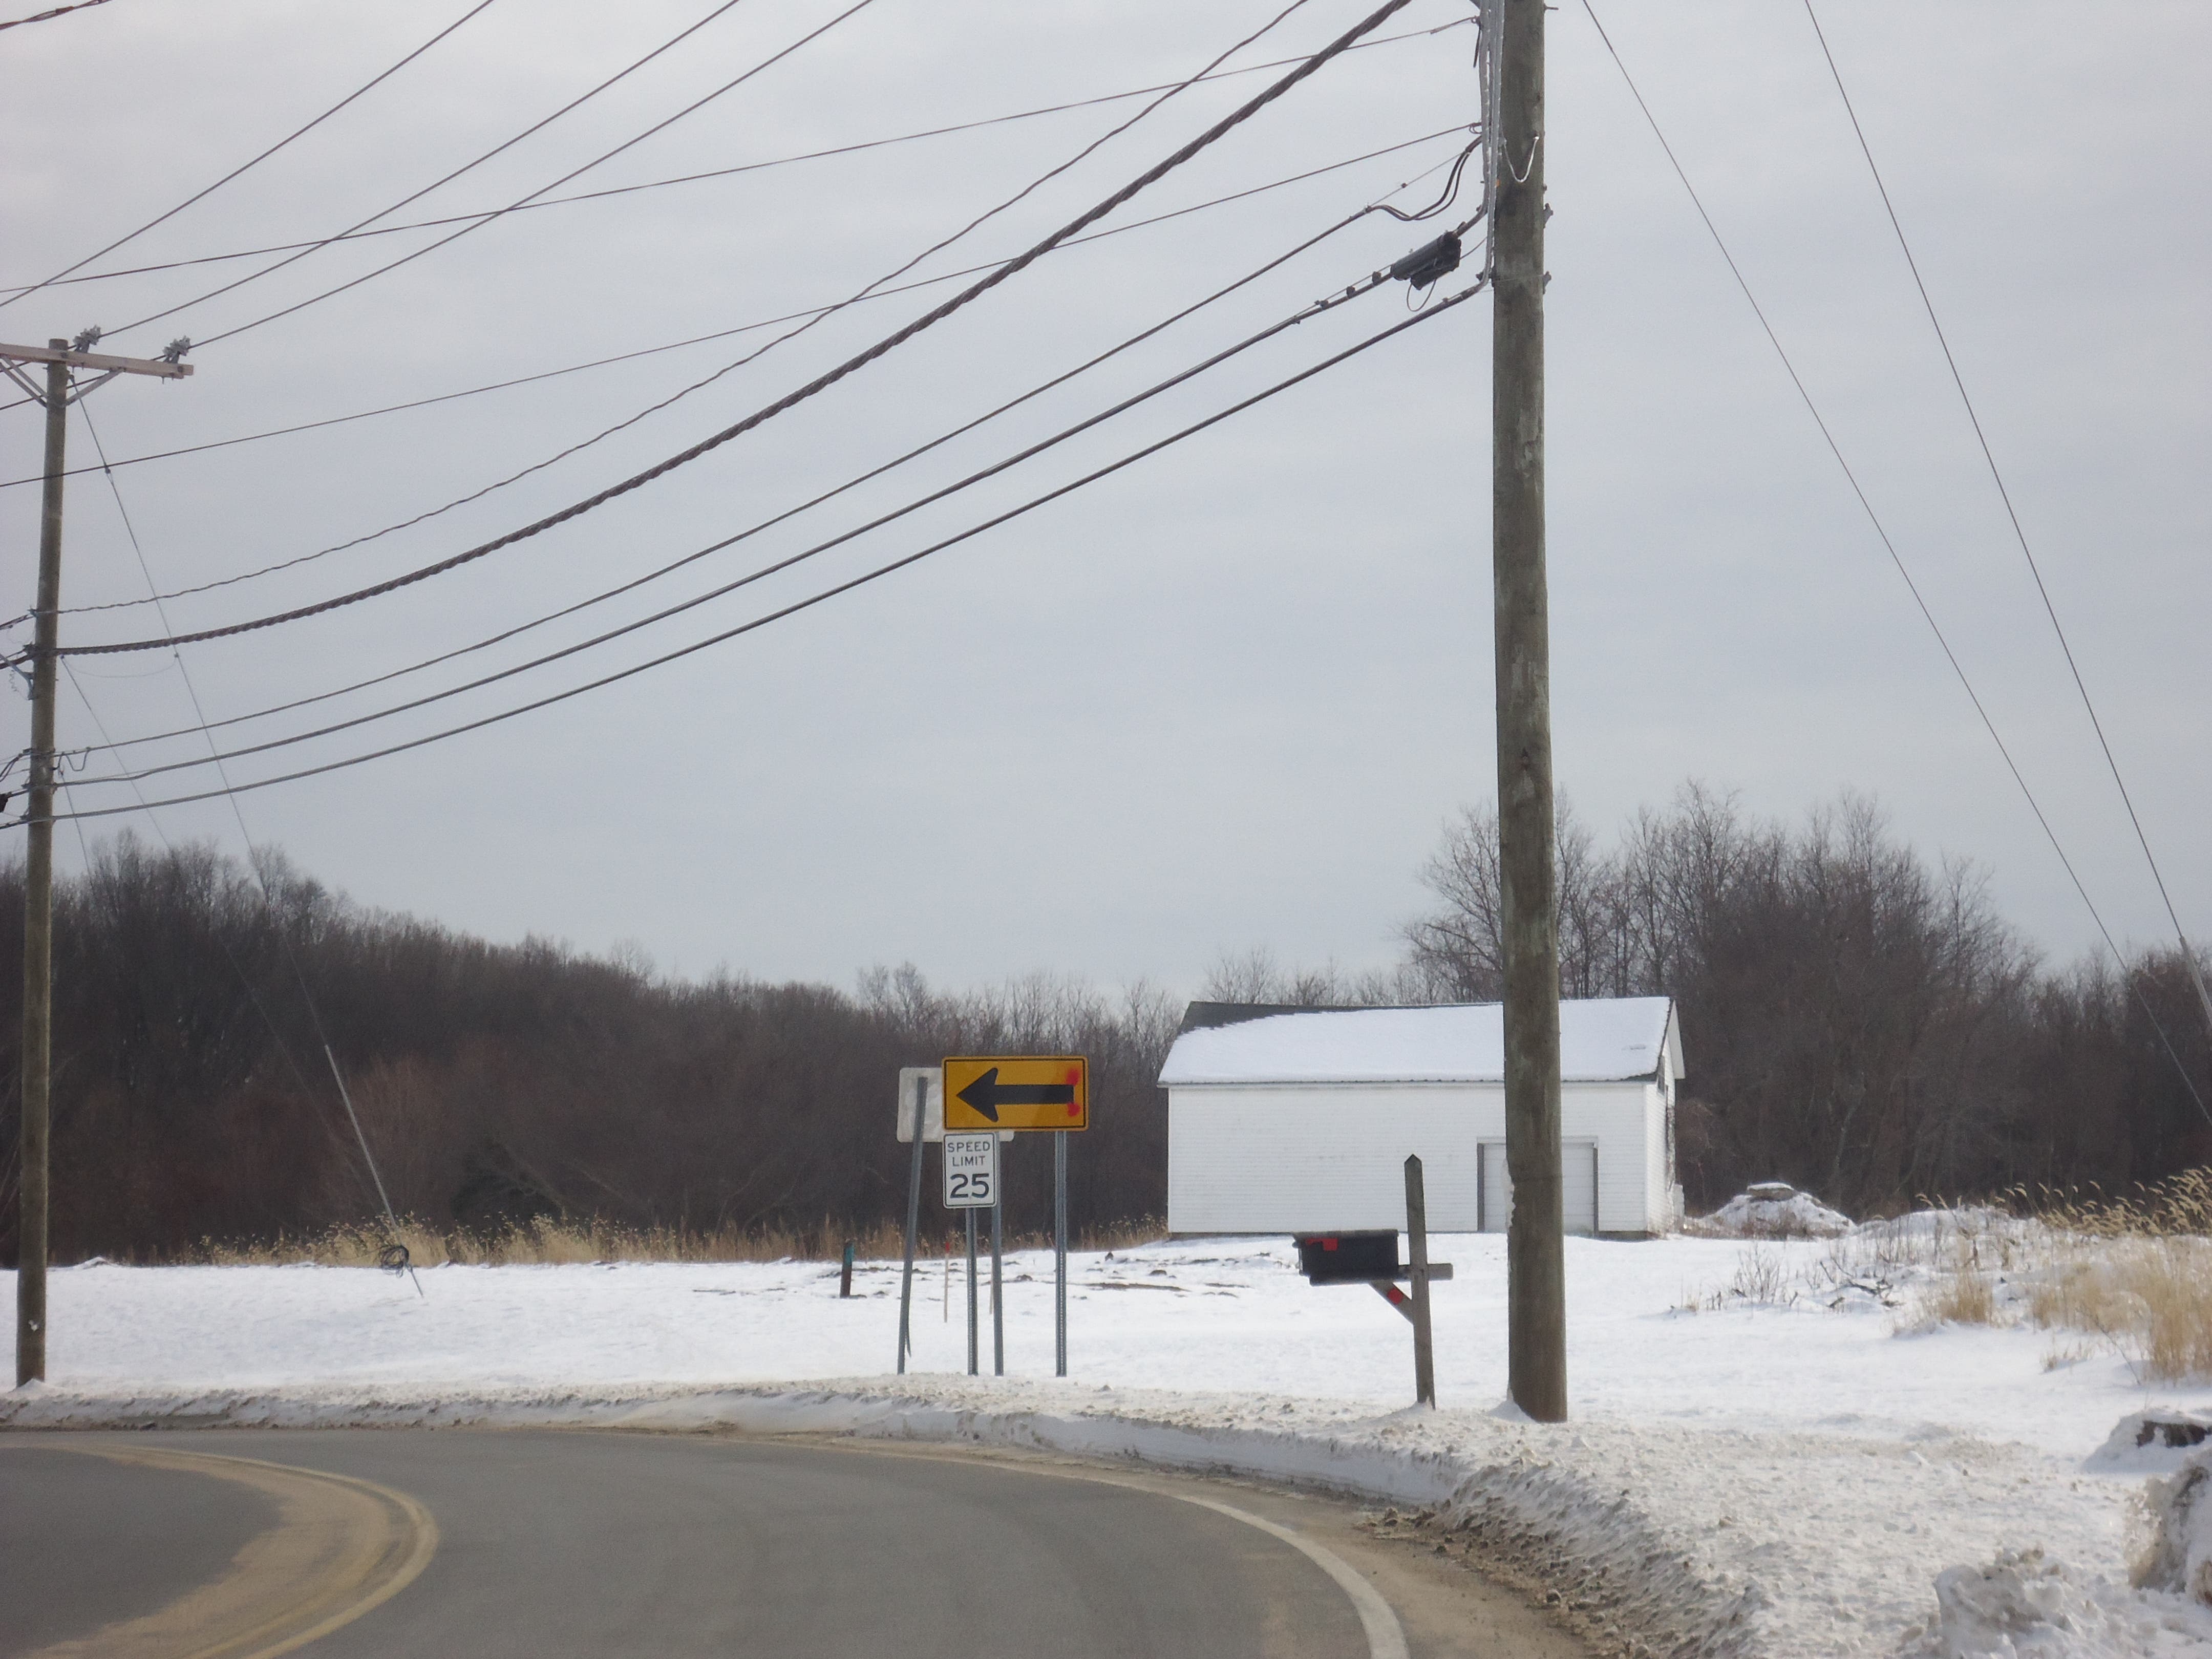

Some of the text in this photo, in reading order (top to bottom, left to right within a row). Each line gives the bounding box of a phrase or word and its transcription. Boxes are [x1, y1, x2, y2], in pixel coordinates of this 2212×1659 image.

[947, 1142, 990, 1153] SPEED
[952, 1156, 986, 1166] LIMIT
[950, 1173, 990, 1198] 25
